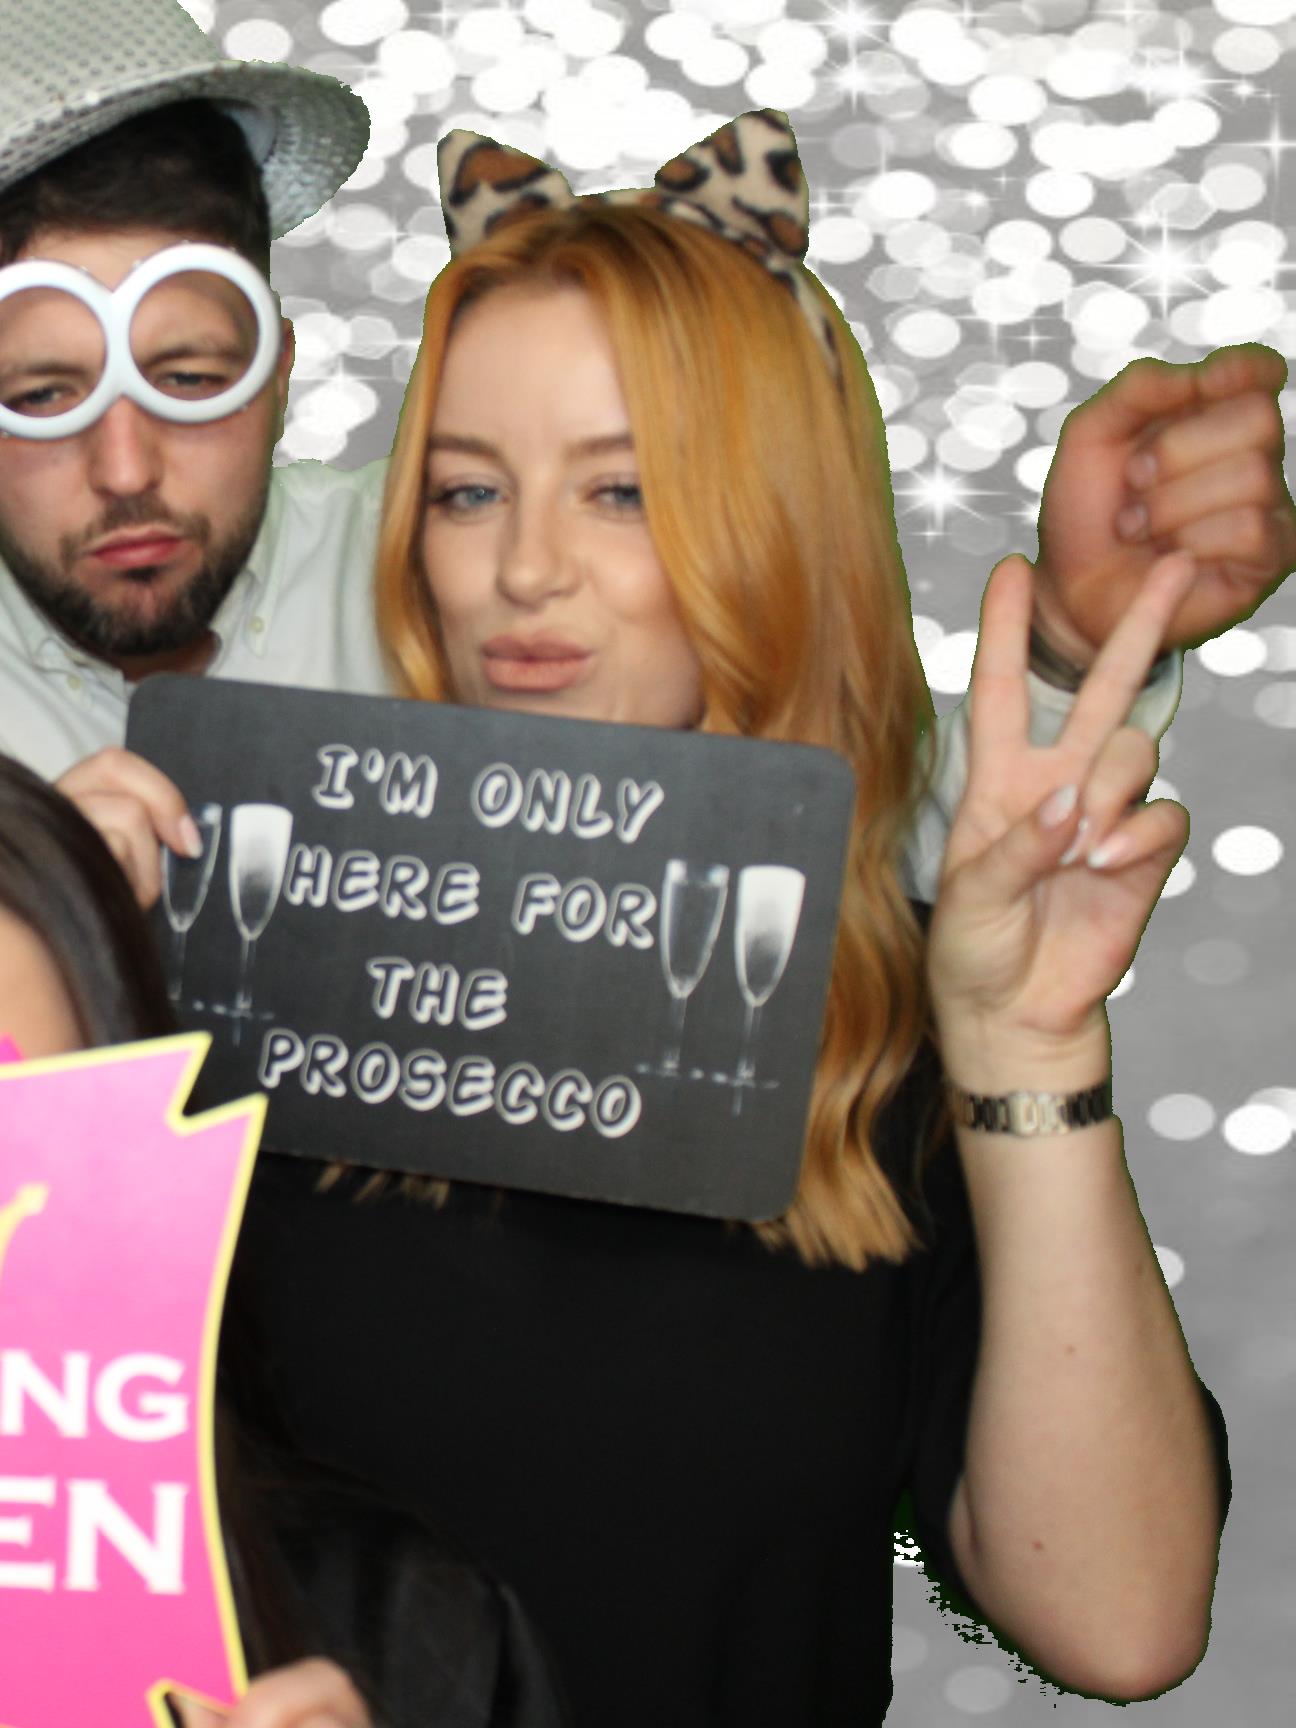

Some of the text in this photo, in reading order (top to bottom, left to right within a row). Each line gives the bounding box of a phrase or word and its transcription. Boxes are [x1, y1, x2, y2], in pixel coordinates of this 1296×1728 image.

[311, 743, 664, 844] I'M ONLY
[282, 843, 659, 950] HERE FOR
[366, 955, 510, 1031] THE
[257, 1027, 642, 1138] PROSECCO
